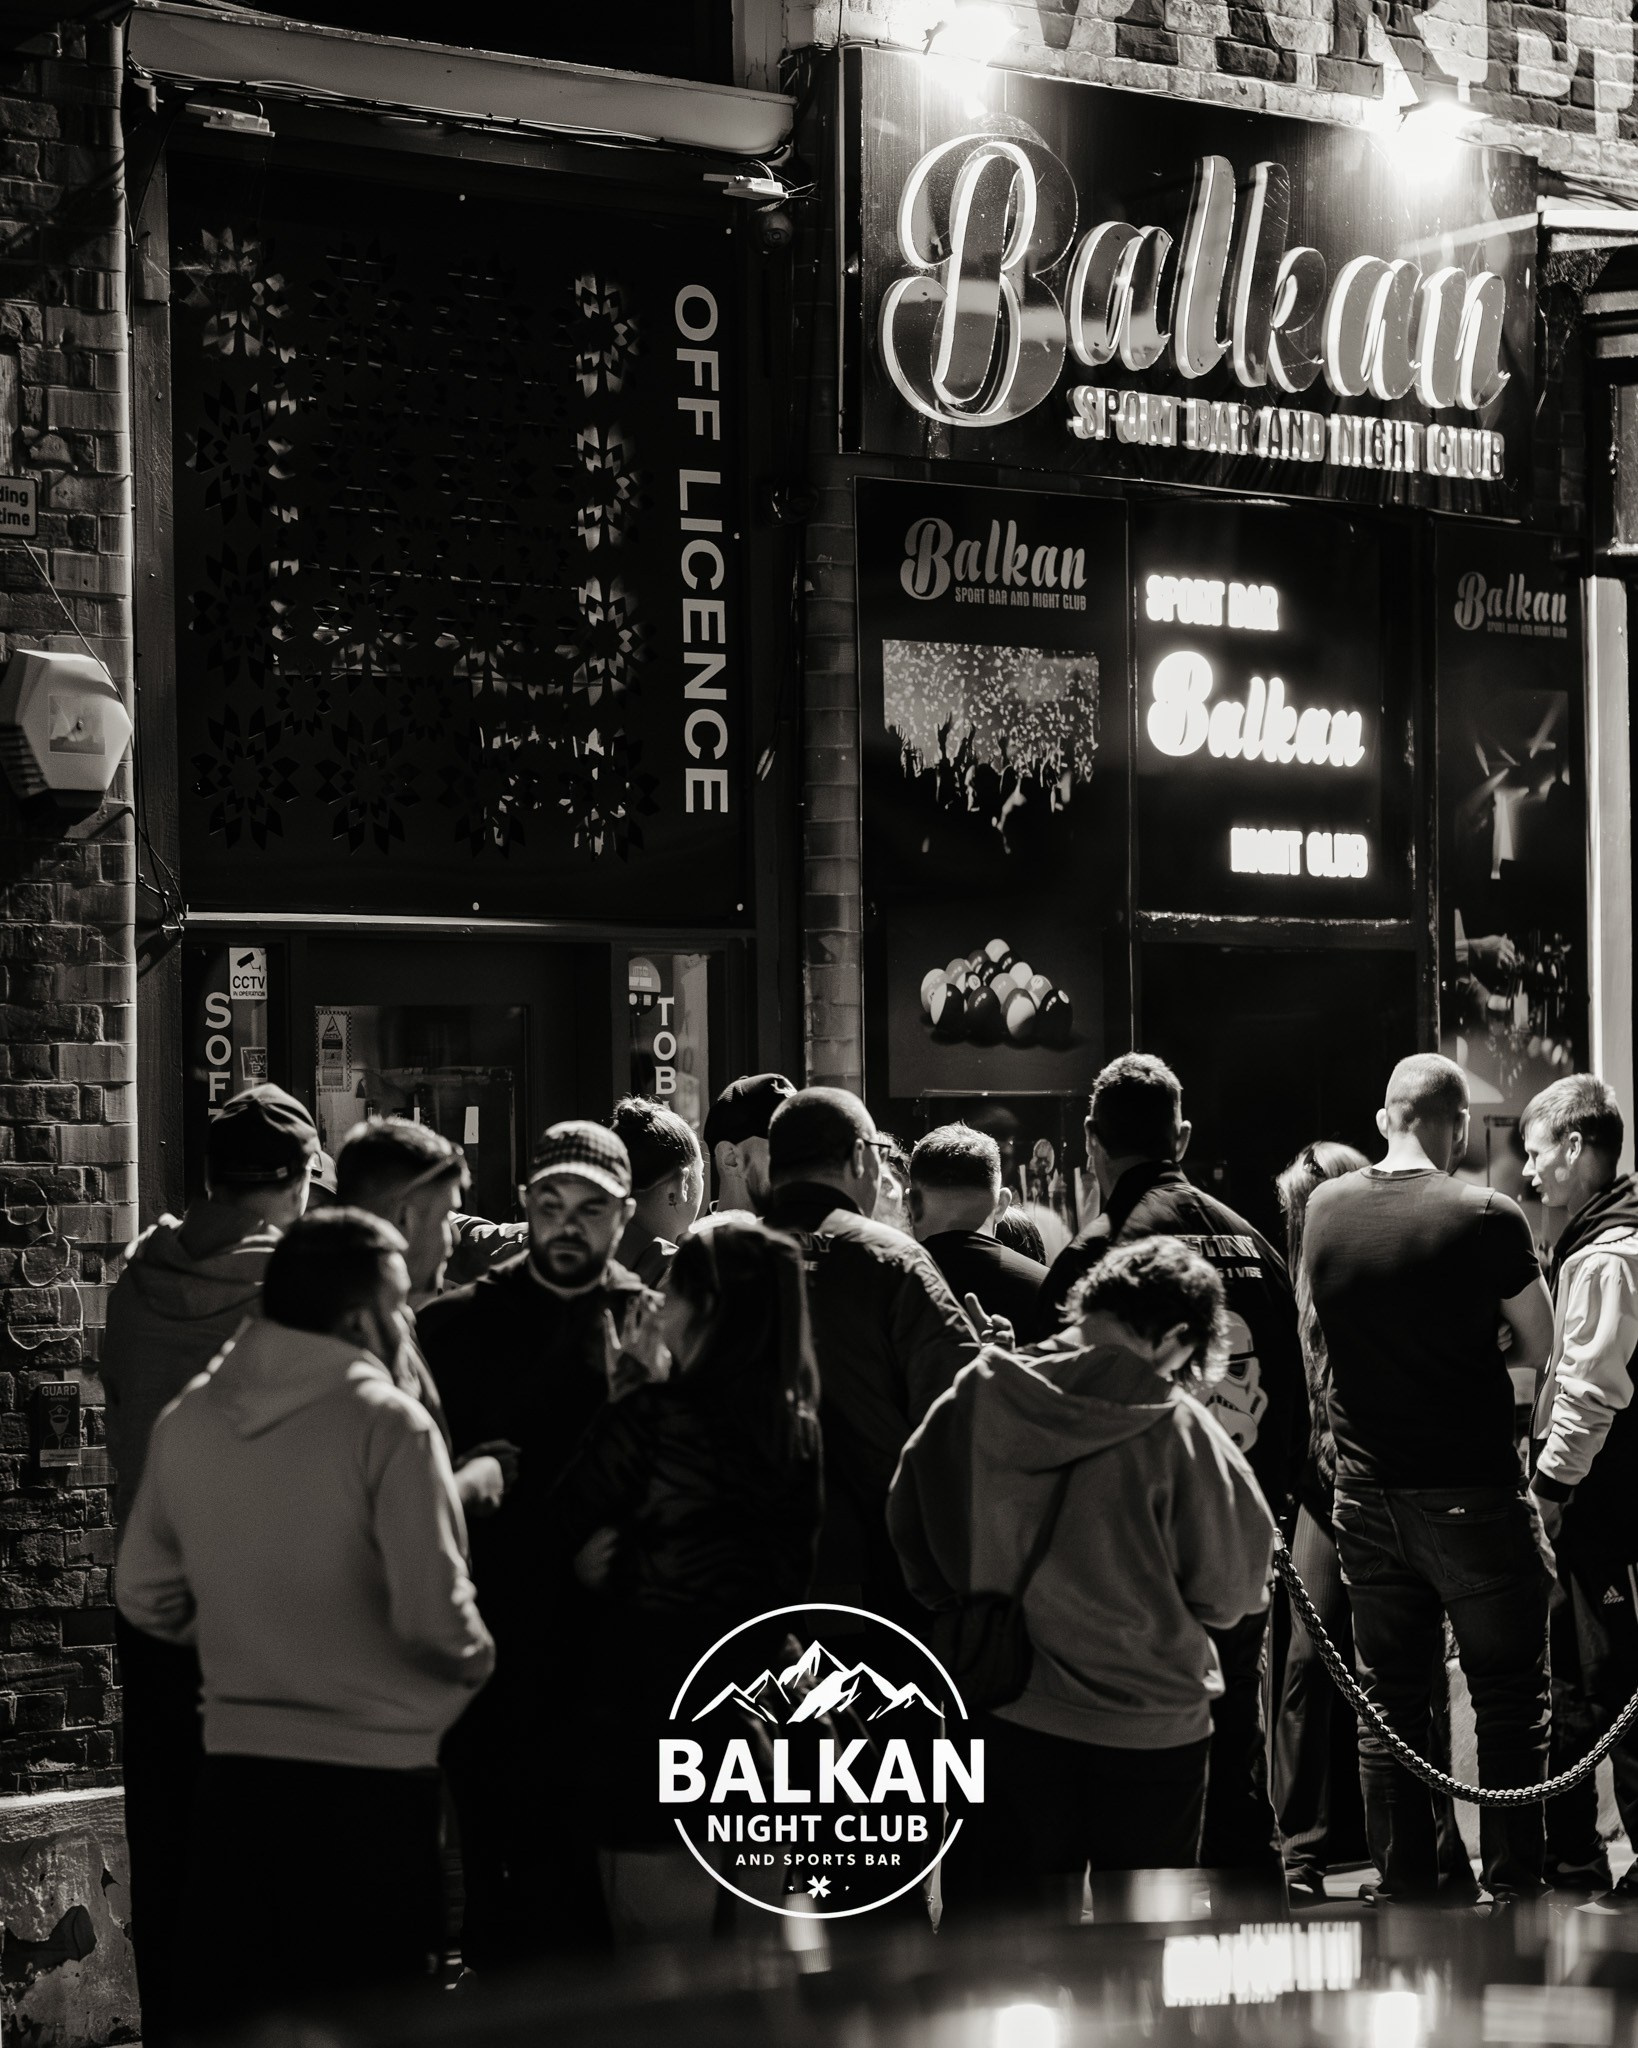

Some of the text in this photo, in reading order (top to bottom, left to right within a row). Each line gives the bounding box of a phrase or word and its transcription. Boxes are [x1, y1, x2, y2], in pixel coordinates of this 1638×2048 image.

[878, 132, 1511, 427] Balkan
[1068, 385, 1506, 481] SPORT BAR AND NIGHT CLUB
[674, 284, 729, 814] OFF LICENCE
[900, 517, 1087, 601] Balkan
[955, 587, 1087, 611] SPORT BAR AND NIGHT CLUB
[1454, 571, 1567, 631] Balkan
[1147, 650, 1366, 768] Balkan
[232, 975, 266, 990] CCTV
[205, 991, 232, 1117] SOF
[653, 996, 677, 1109] TOB
[1235, 1266, 1263, 1279] VIBE
[41, 1385, 78, 1396] GUARD
